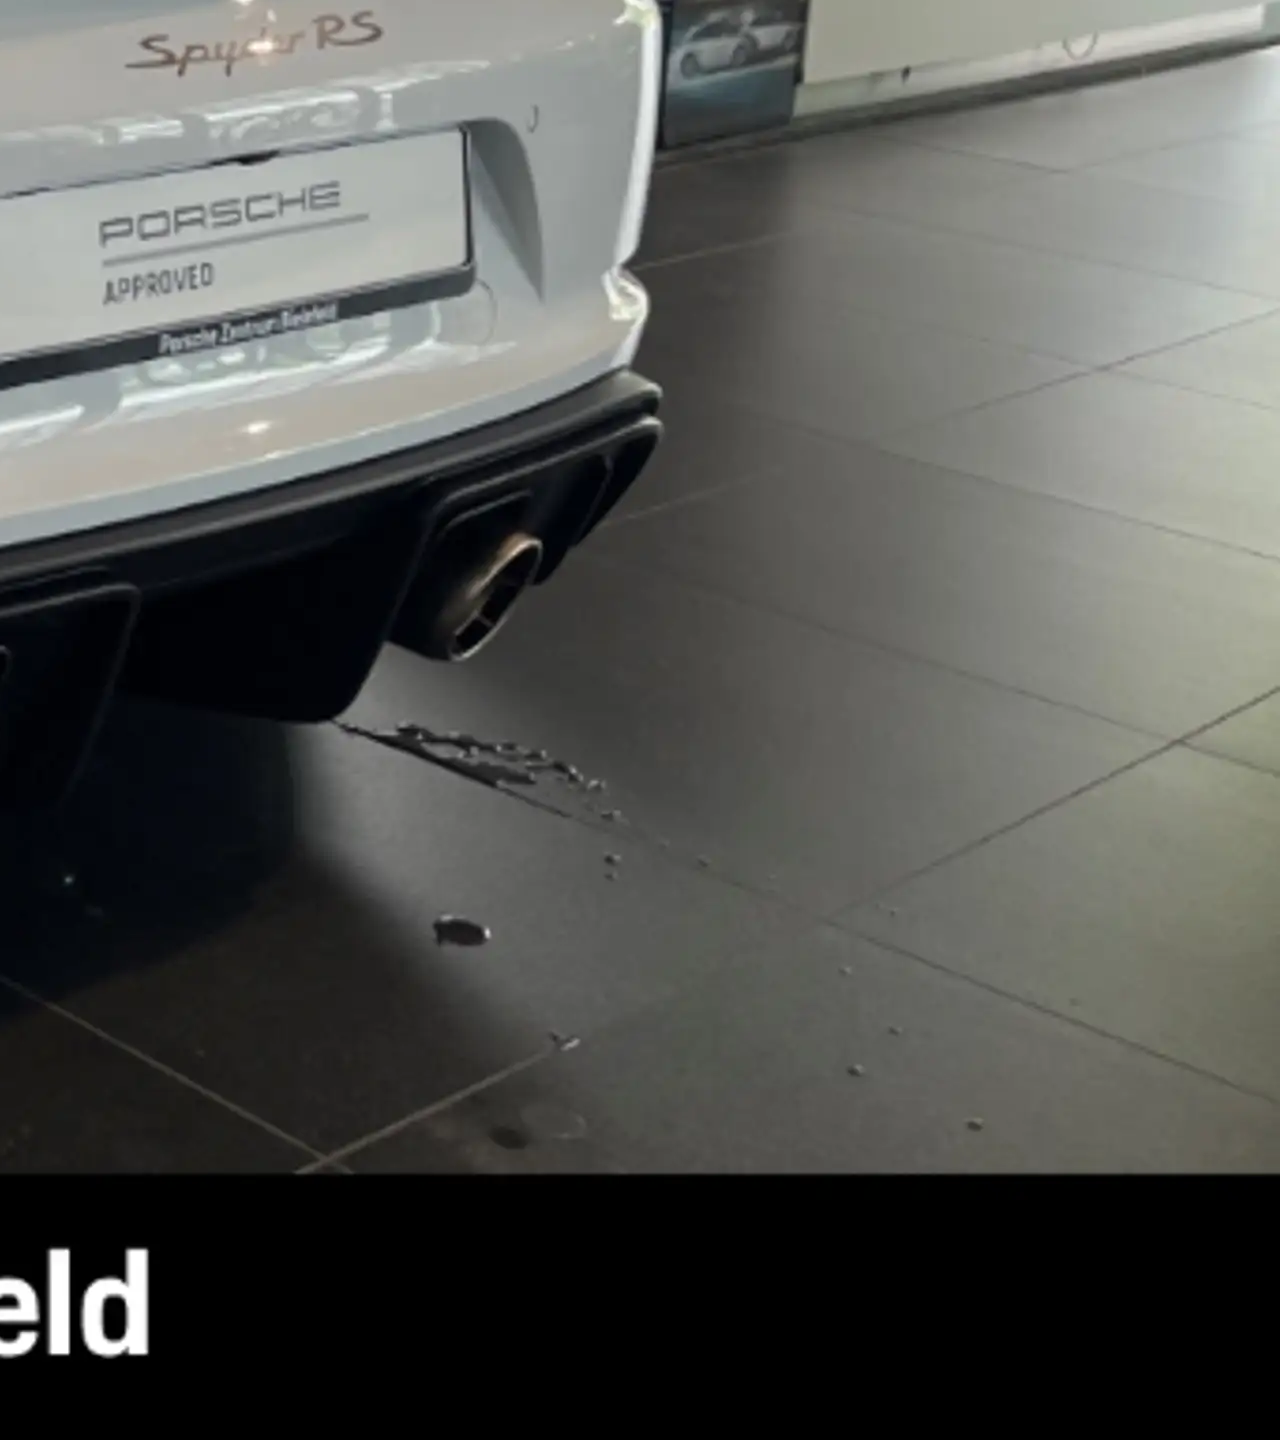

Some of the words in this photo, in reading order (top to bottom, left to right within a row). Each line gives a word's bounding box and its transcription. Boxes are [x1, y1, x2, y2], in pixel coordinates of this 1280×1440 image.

[124, 26, 306, 78] Spyder
[312, 10, 384, 50] RS
[98, 180, 341, 248] PORSCHE
[102, 262, 215, 306] APPROVED
